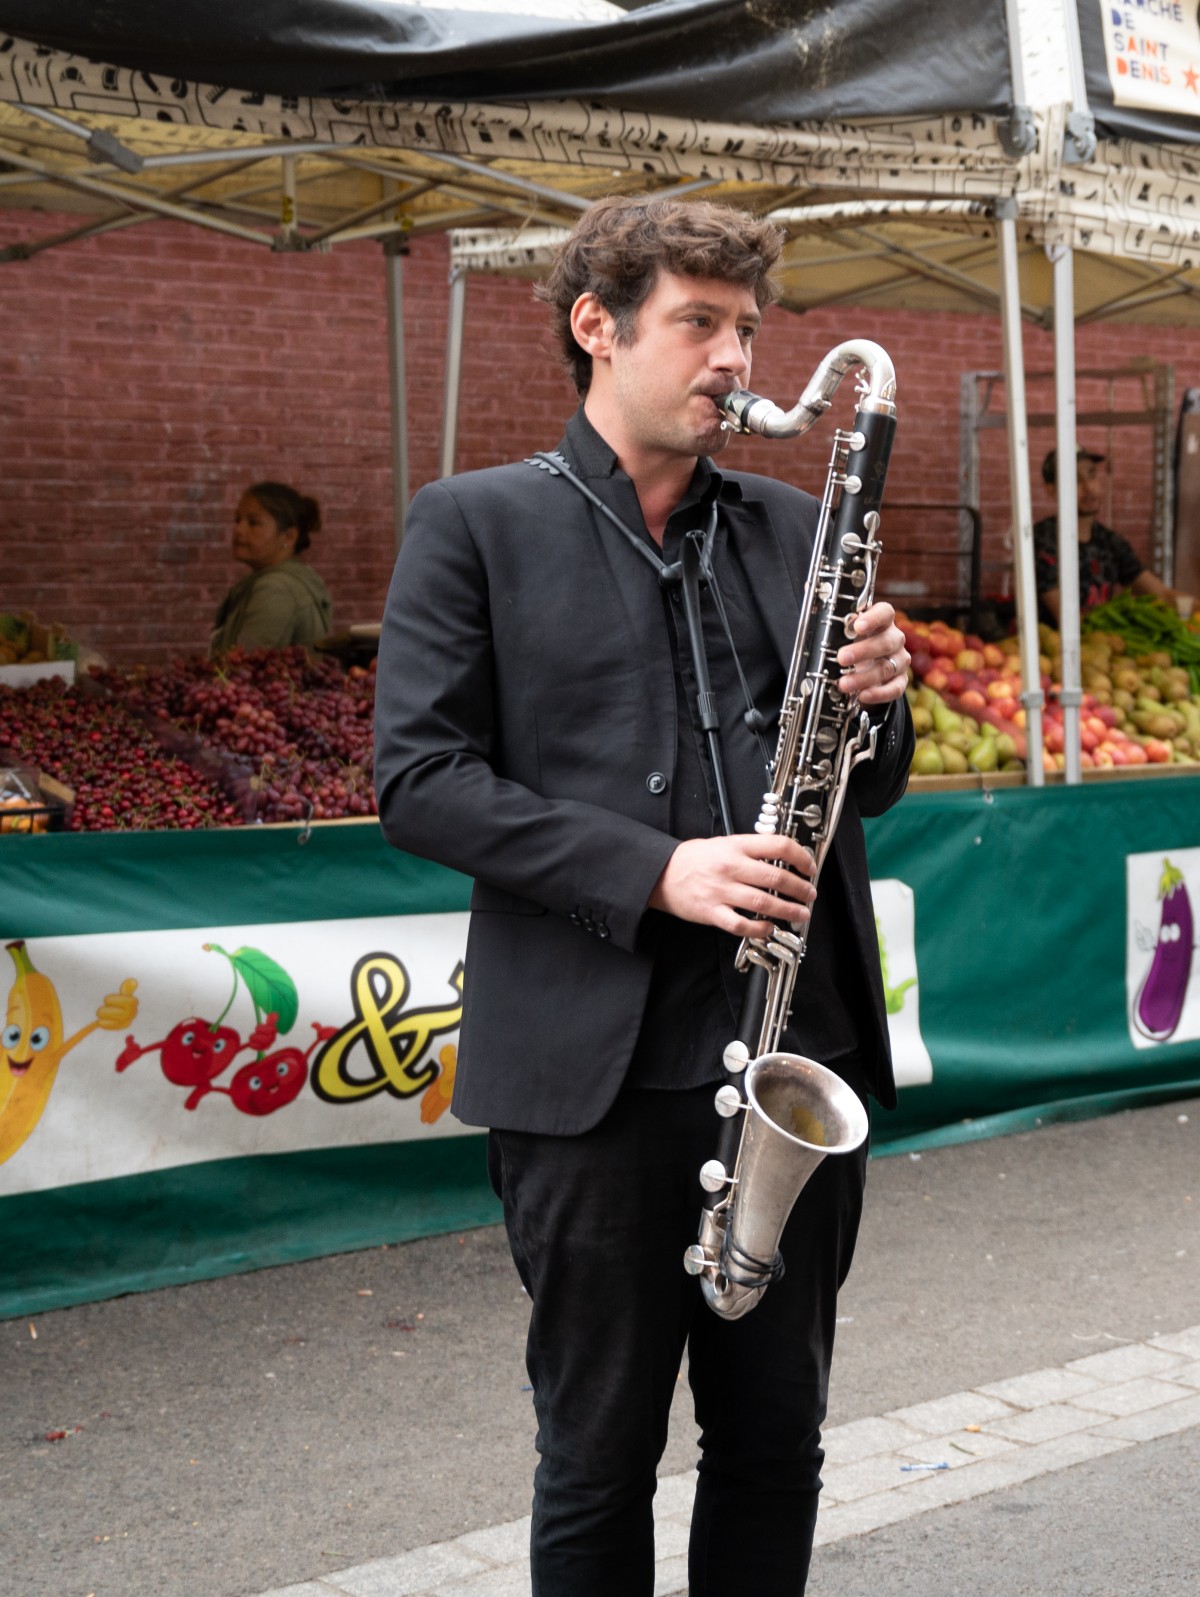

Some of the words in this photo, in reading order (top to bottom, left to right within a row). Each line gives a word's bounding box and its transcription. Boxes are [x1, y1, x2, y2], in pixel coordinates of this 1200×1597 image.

[1111, 8, 1135, 30] DE
[1114, 32, 1169, 61] SAINT
[1116, 56, 1172, 86] DENIS
[310, 950, 464, 1105] &
